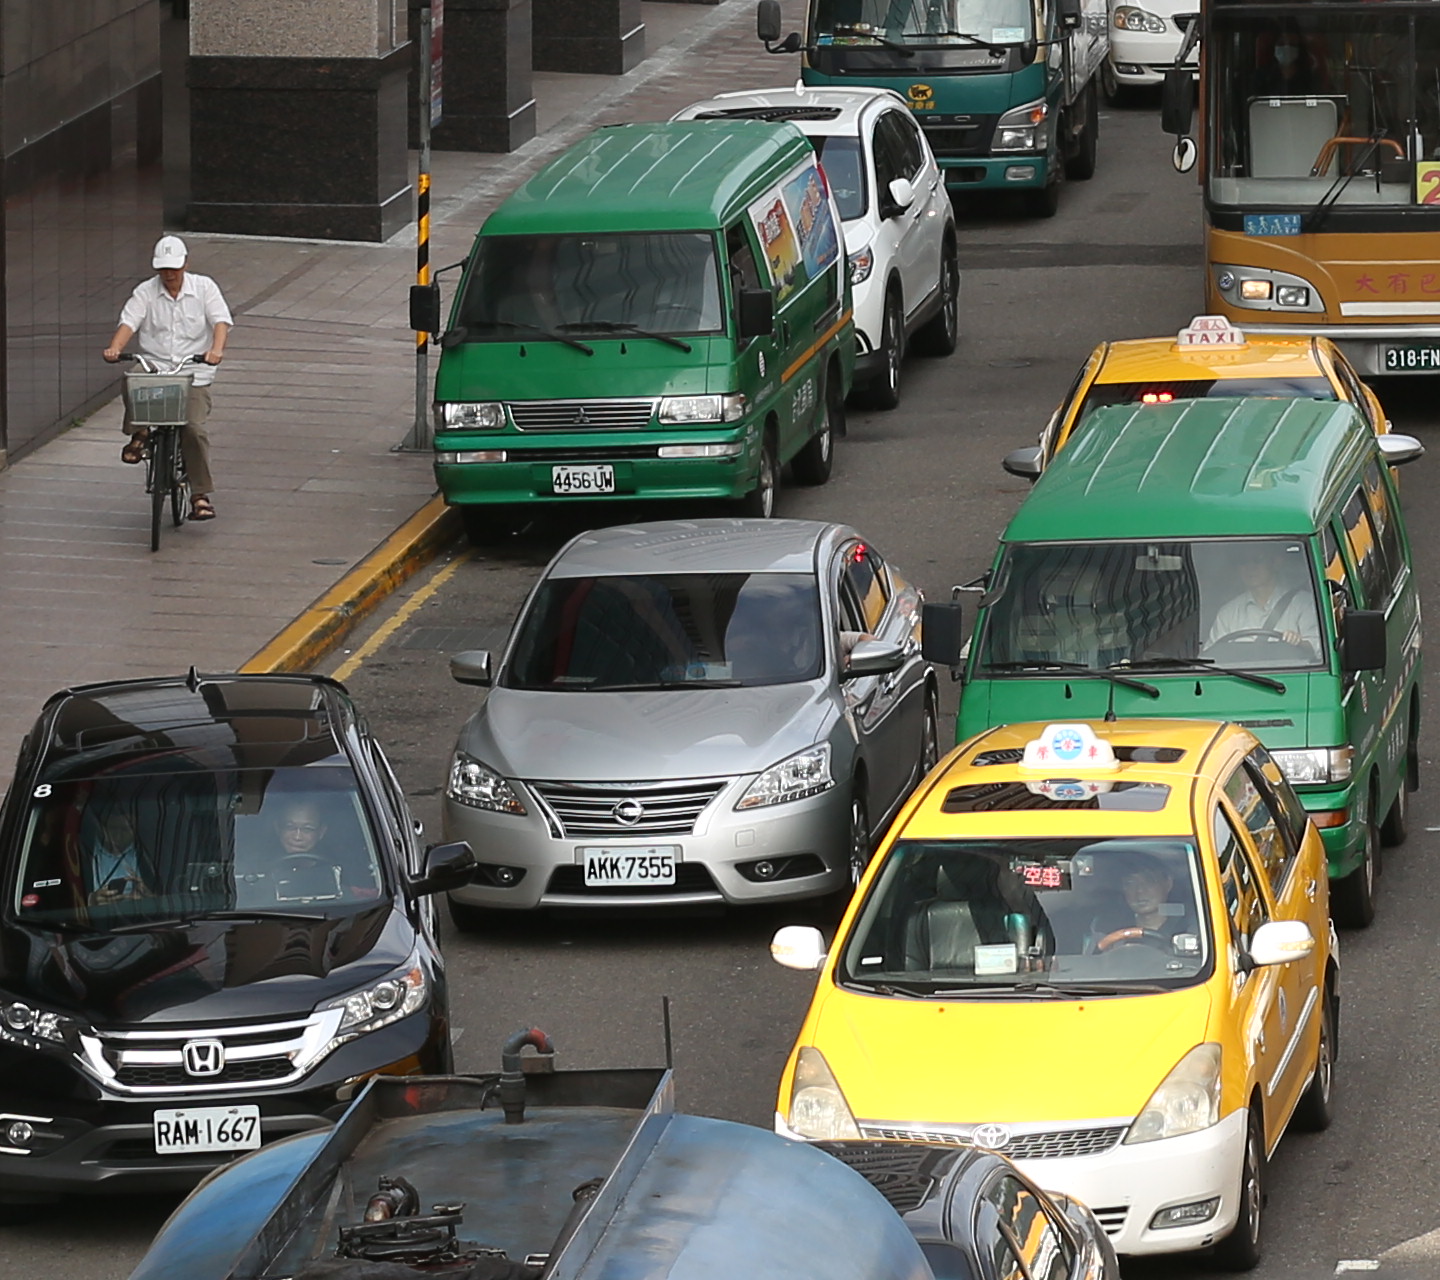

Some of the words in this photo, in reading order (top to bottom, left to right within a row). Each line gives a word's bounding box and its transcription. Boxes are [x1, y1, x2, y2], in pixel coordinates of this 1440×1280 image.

[1187, 333, 1235, 344] TAXI
[1387, 349, 1440, 368] 318-FN
[554, 471, 613, 491] 4456-UW
[33, 784, 52, 798] 8
[587, 856, 671, 880] AKK-7355
[1023, 866, 1060, 888] 空車
[156, 1116, 257, 1148] RAM-1667
